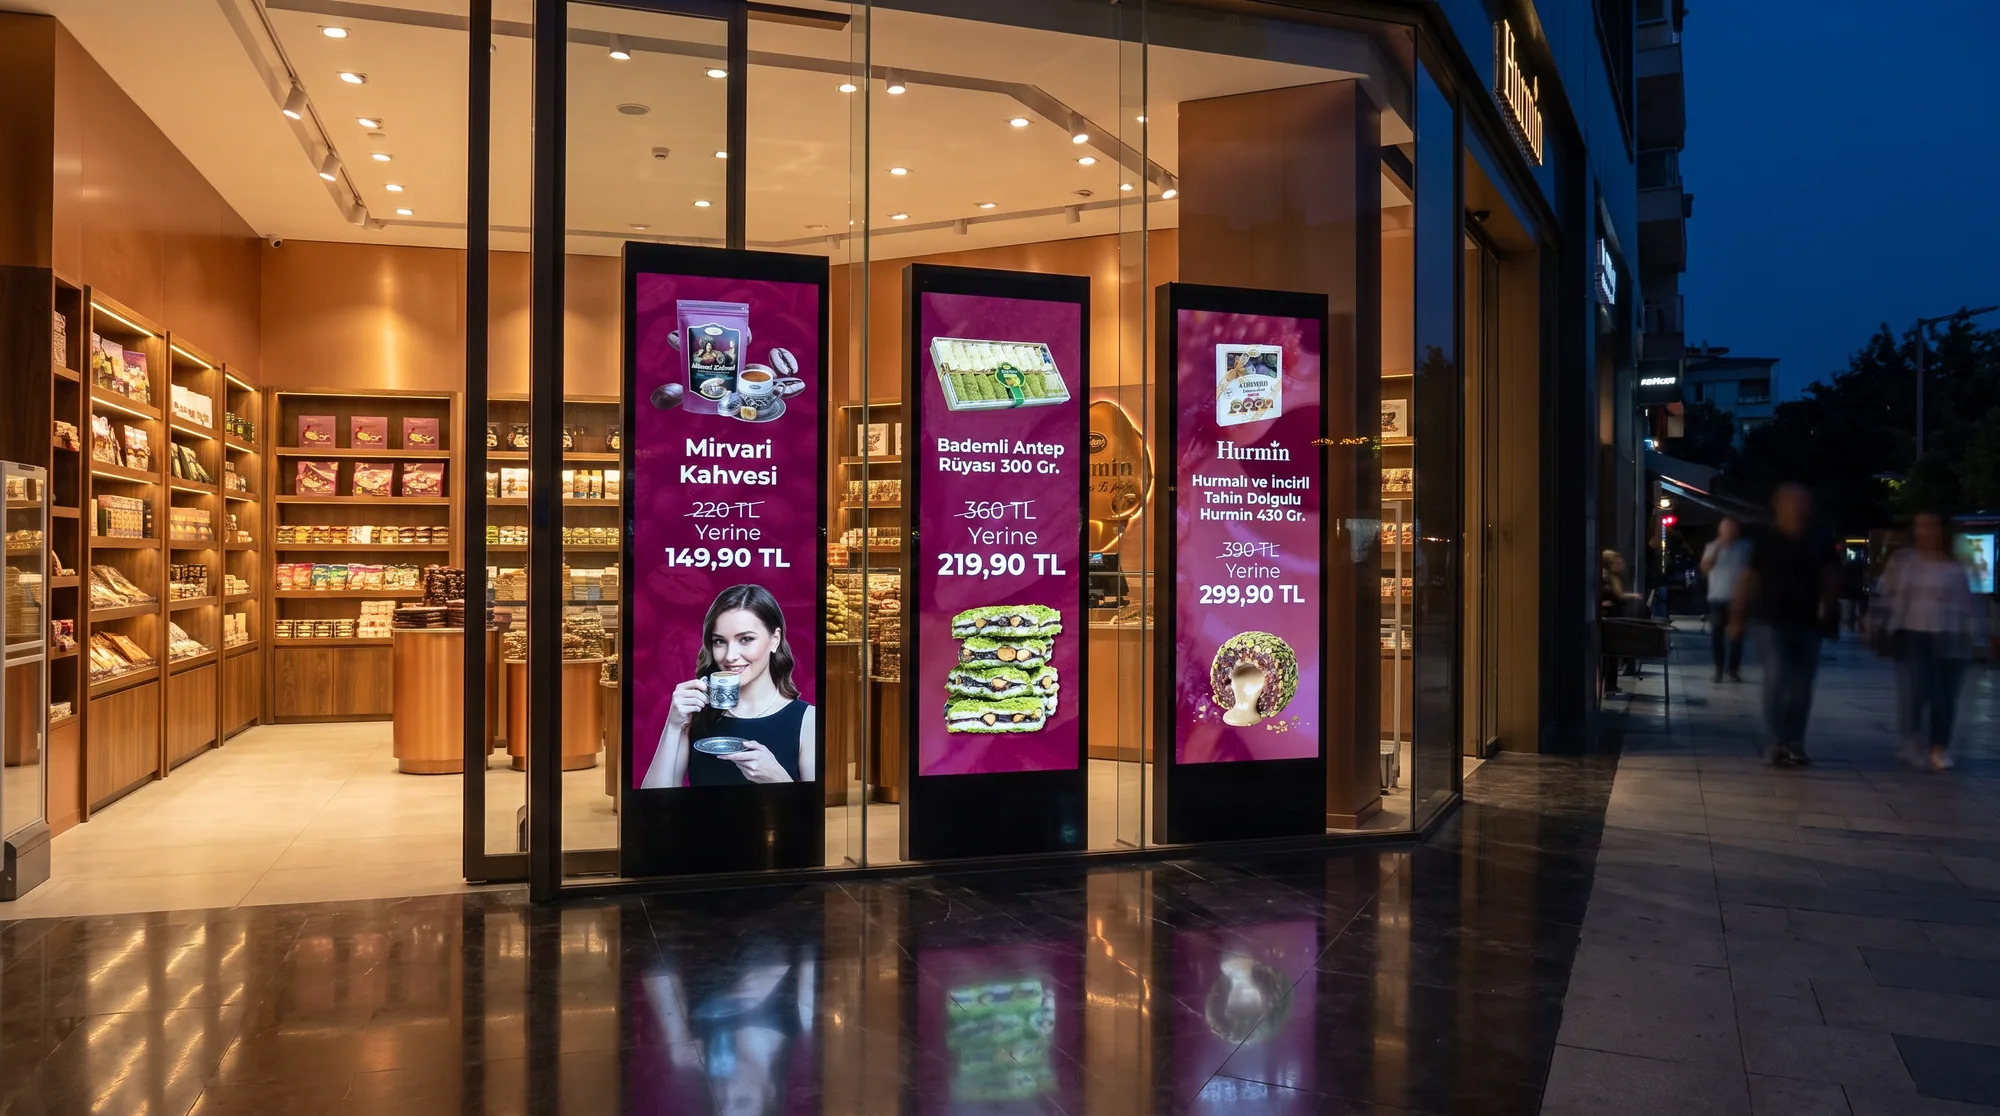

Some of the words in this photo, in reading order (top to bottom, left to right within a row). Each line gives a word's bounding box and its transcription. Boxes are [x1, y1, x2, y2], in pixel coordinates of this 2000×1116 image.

[1504, 19, 1543, 166] Hurmin
[686, 437, 772, 459] Mirvari
[937, 437, 1009, 454] Bademli
[1012, 440, 1065, 459] Antep
[1216, 440, 1291, 461] Hurmin
[680, 464, 777, 486] Kahvesi
[939, 456, 996, 476] Rüyası
[1000, 459, 1033, 474] 300
[1036, 459, 1060, 475] Gr.
[1192, 474, 1248, 488] Hurmalı
[1251, 478, 1268, 488] ve
[1203, 491, 1243, 504] Tahin
[1247, 492, 1302, 508] Dolgulu
[692, 502, 730, 518] 220
[735, 502, 761, 519] TL
[964, 501, 1005, 520] 360
[1010, 501, 1037, 520] TL
[1200, 508, 1253, 521] Hurmin
[1256, 509, 1283, 522] 430
[1286, 509, 1306, 522] Gr.
[694, 523, 761, 541] Yerine
[967, 526, 1038, 545] Yerine
[1222, 541, 1256, 558] 390
[1258, 542, 1280, 558] TL
[665, 547, 752, 572] 149,90
[758, 548, 791, 568] TL
[937, 553, 1026, 580] 219,90
[1032, 553, 1066, 576] TL
[1225, 563, 1281, 579] Yerine
[1199, 584, 1275, 608] 299,90
[1278, 584, 1306, 604] TL
